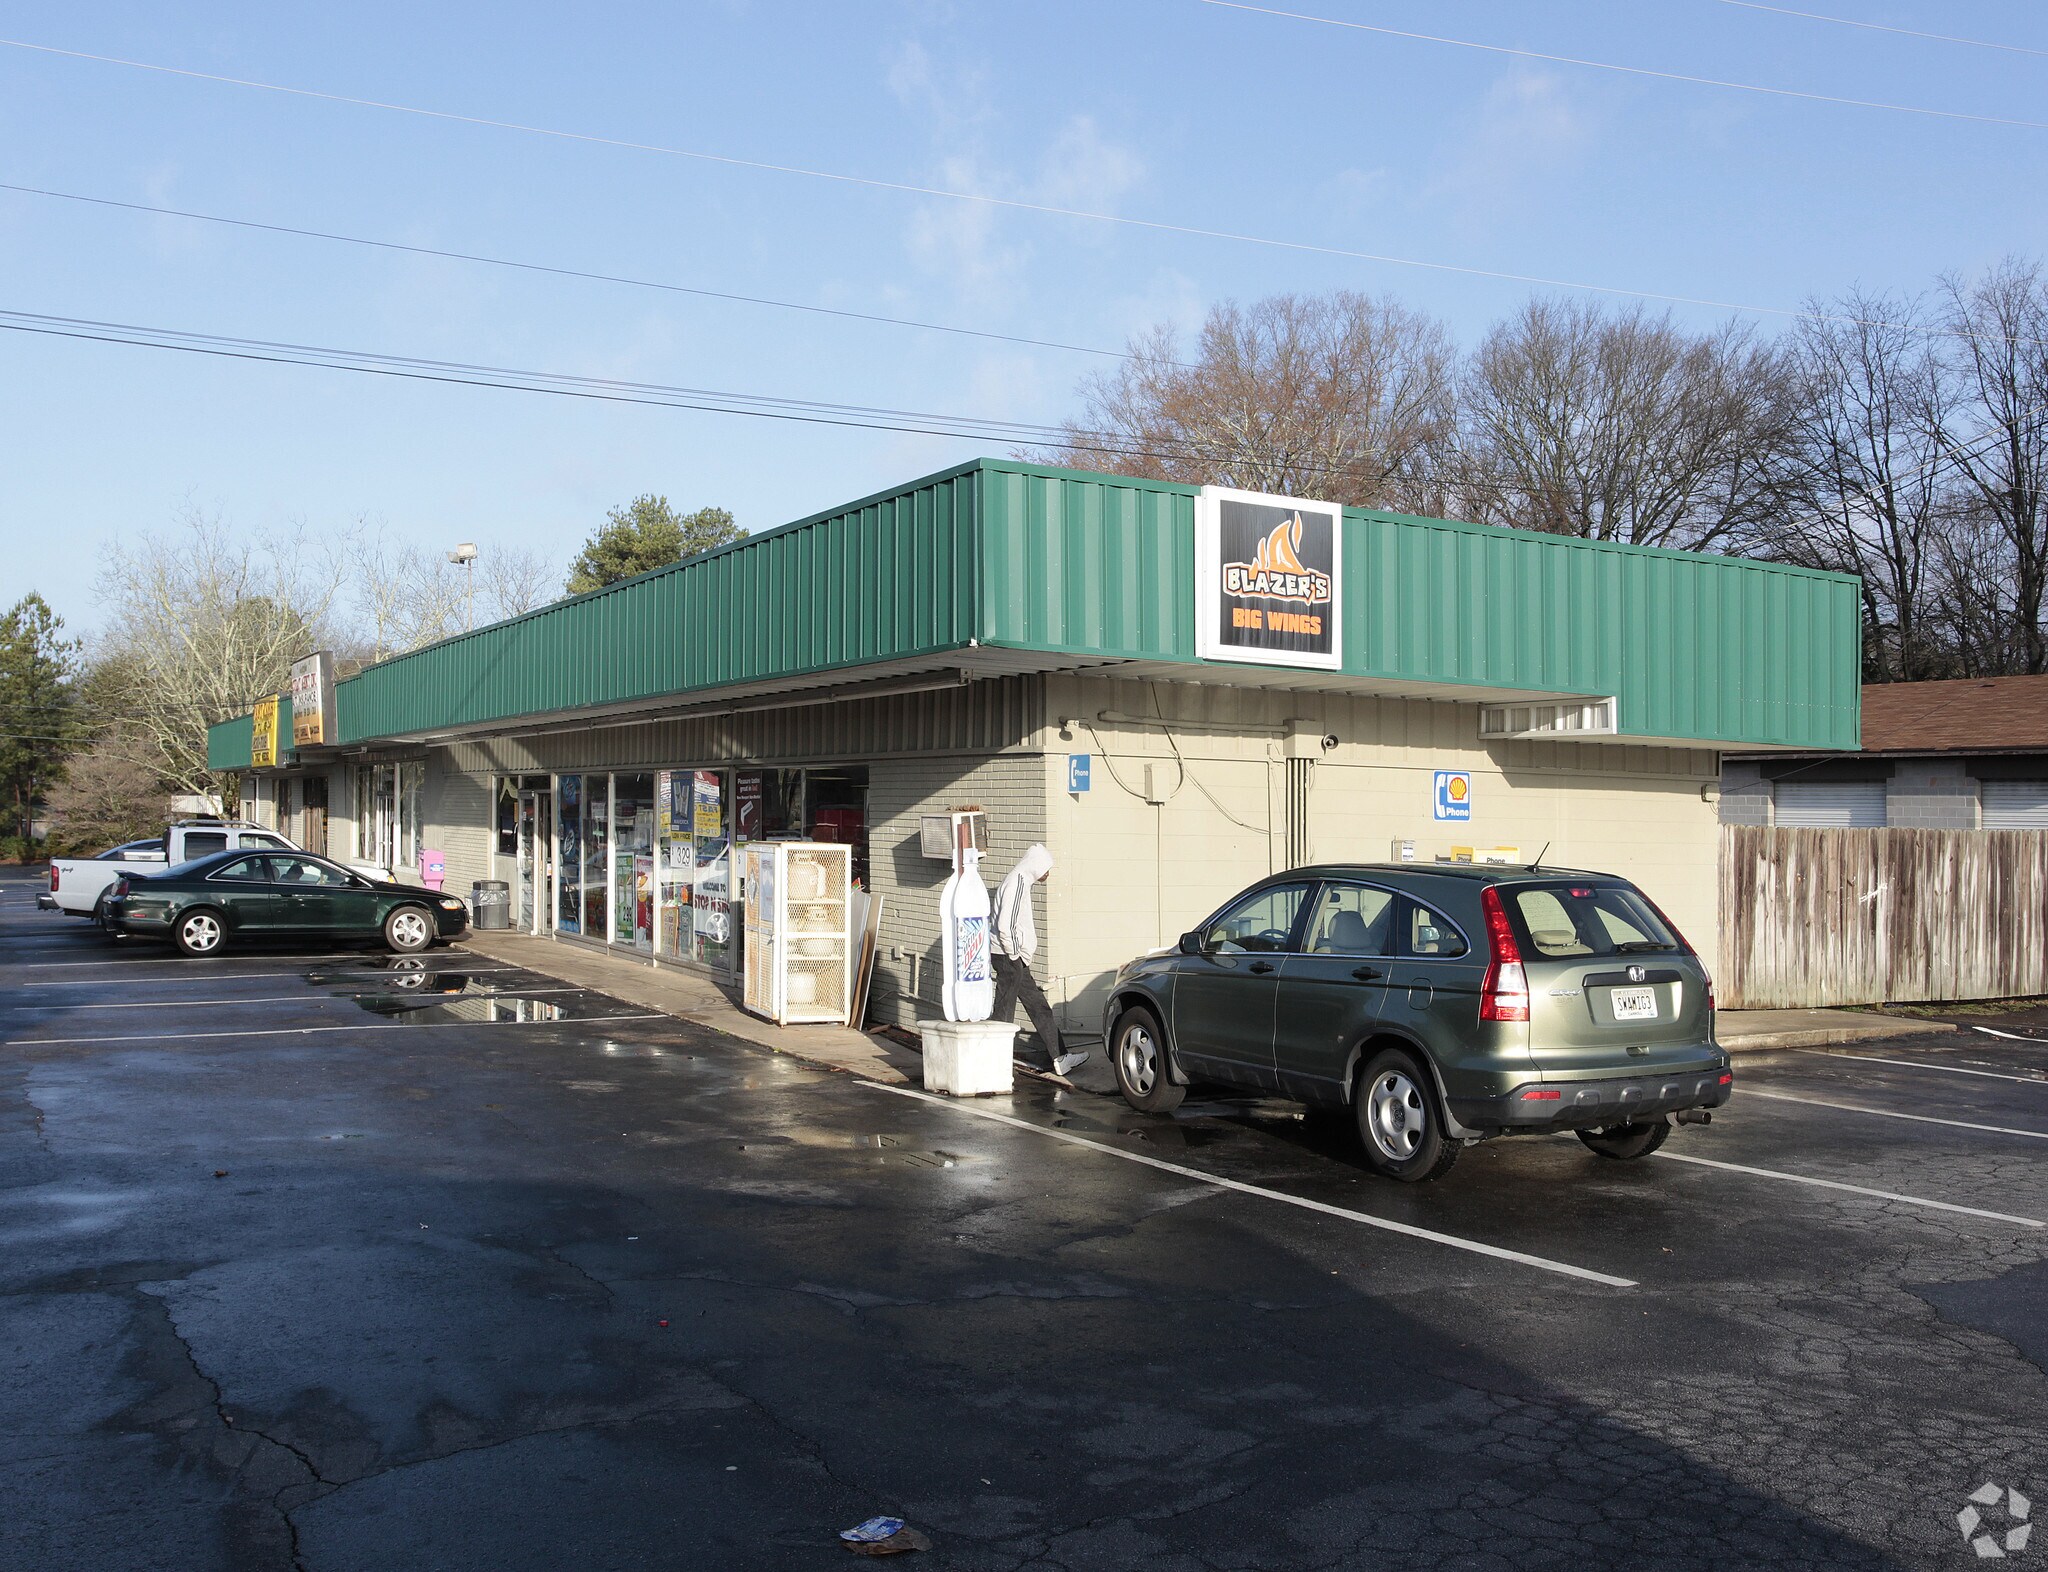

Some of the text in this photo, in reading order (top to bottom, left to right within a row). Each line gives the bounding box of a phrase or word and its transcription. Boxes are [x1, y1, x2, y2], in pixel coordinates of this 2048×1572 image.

[1227, 566, 1328, 599] BLAZER'S
[1232, 607, 1322, 635] BIG WINGS
[1074, 769, 1089, 777] Phone
[1446, 807, 1469, 817] Phone
[703, 882, 727, 893] WELCOME TO
[695, 894, 709, 910] STOP
[711, 896, 716, 912] N
